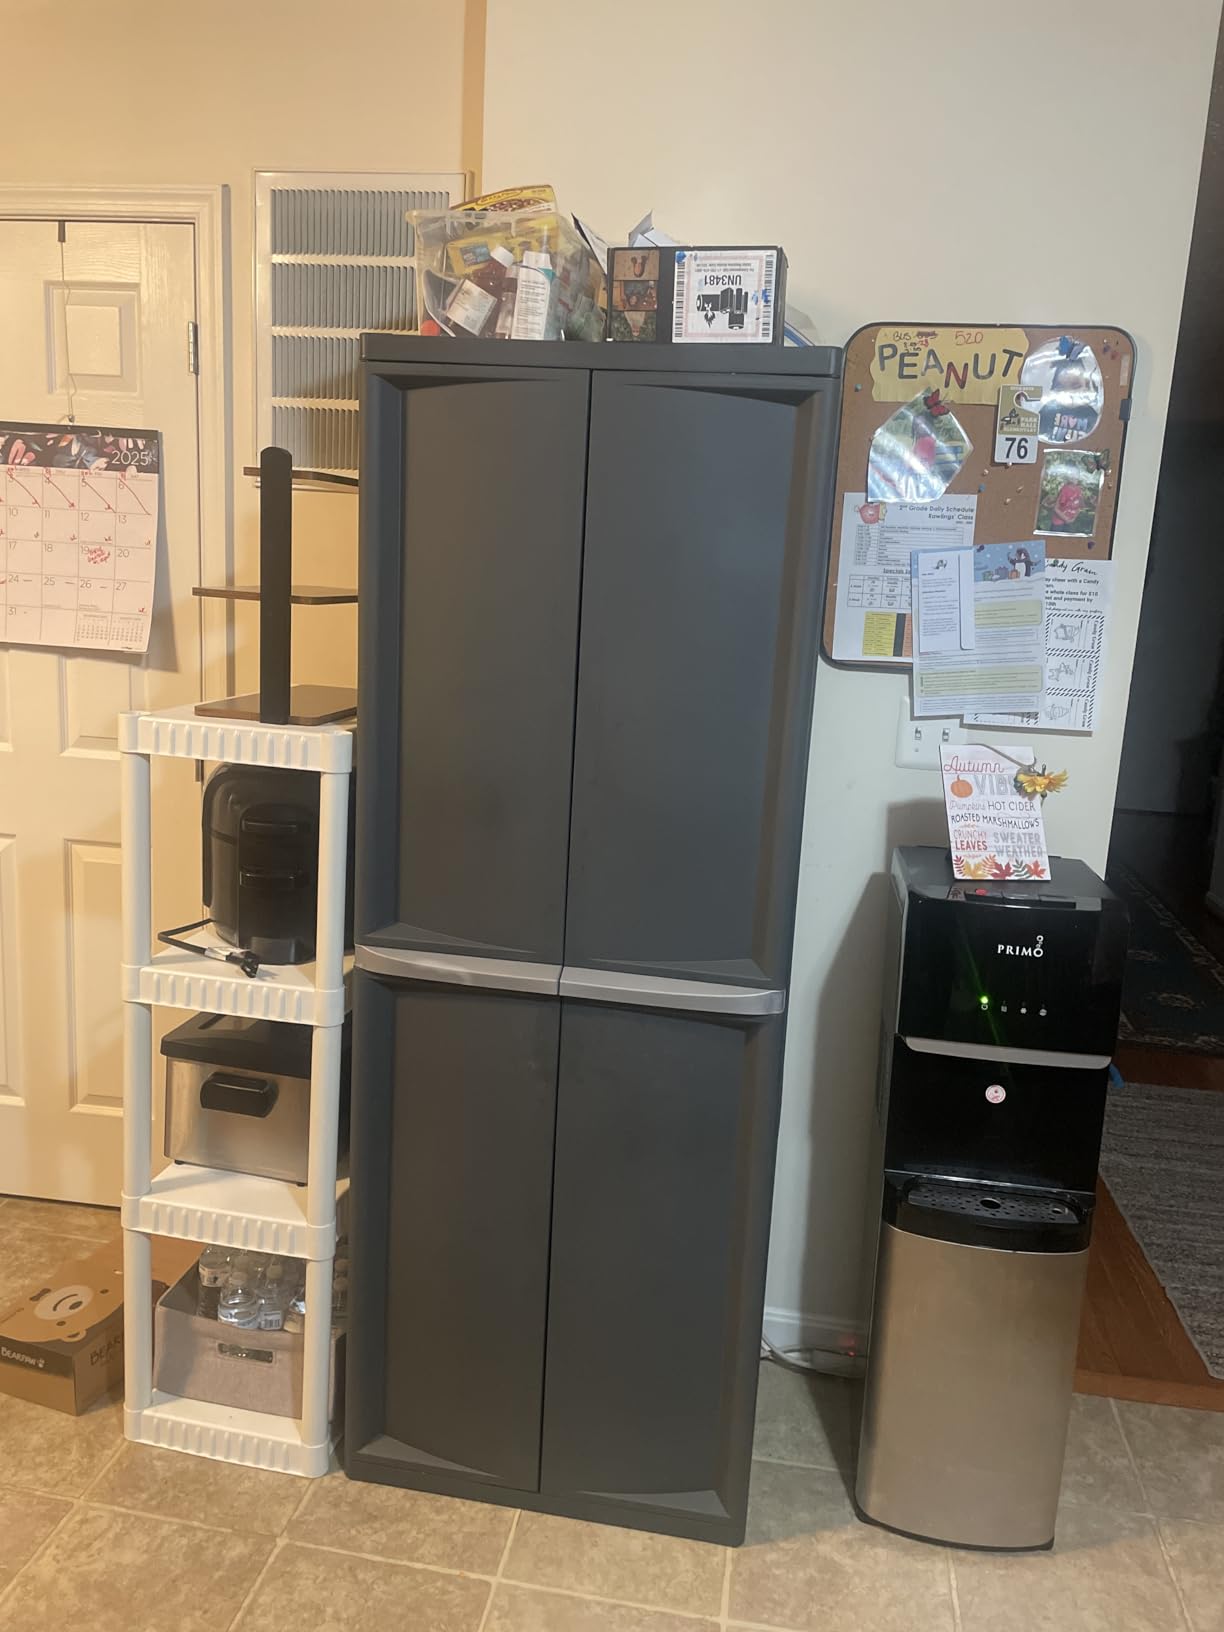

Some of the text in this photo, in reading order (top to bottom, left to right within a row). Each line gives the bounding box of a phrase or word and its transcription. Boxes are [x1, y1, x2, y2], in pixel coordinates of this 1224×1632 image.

[704, 274, 742, 286] UN3481
[955, 331, 984, 346] 520
[878, 343, 1024, 390] PEANUT
[1005, 437, 1029, 460] 76
[111, 450, 150, 467] 2025
[9, 507, 19, 517] 10
[44, 510, 51, 519] 11
[929, 505, 944, 514] Daily
[945, 506, 975, 514] Schedule
[80, 512, 90, 522] 12
[118, 515, 127, 525] 13
[957, 513, 974, 521] Class
[9, 541, 17, 550] 17
[44, 543, 54, 553] 18
[80, 546, 90, 555] 19
[117, 549, 130, 558] 20
[8, 574, 19, 583] 24
[43, 577, 56, 586] 25
[80, 580, 92, 589] 26
[116, 582, 127, 591] 27
[8, 607, 17, 616] 31
[944, 756, 1005, 774] Autumn
[949, 800, 1036, 812] Pumpkins HOT CIDER
[951, 813, 1040, 830] ROASTED MARSHMALLOWS
[953, 829, 987, 840] CRUNCHY
[993, 831, 1041, 845] SWEATER
[955, 840, 988, 852] LEAVES
[994, 844, 1044, 858] WEATHER
[997, 942, 1044, 958] PRIMO
